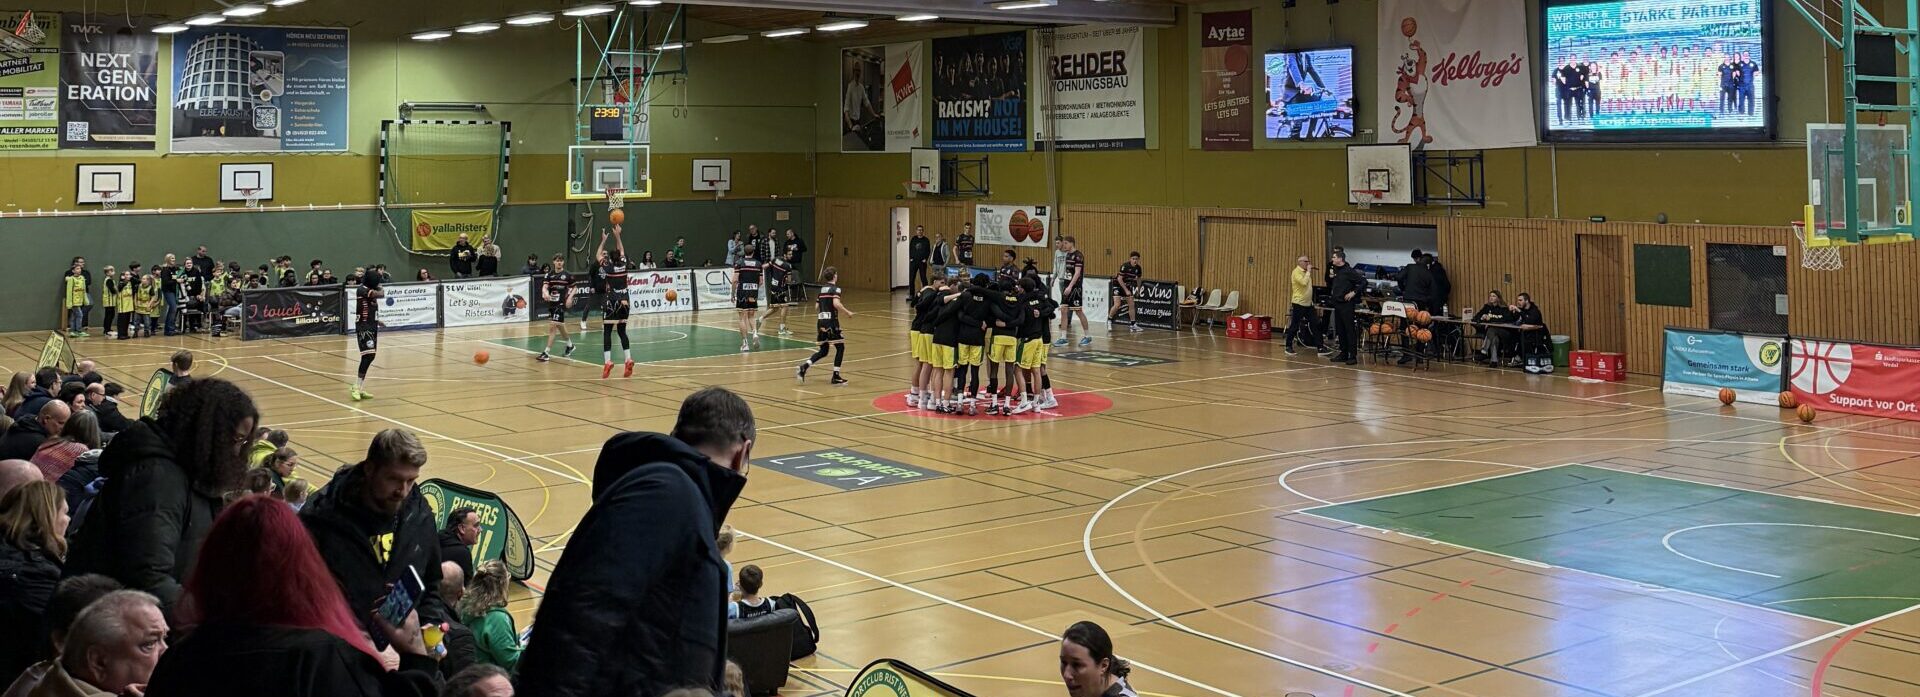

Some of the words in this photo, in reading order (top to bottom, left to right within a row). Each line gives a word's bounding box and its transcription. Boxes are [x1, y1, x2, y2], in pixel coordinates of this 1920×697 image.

[1552, 13, 1571, 22] WIR
[1574, 11, 1598, 20] SIND
[1622, 9, 1676, 23] STARKE
[1682, 3, 1749, 19] PARTNER
[1552, 22, 1571, 31] WIR
[1575, 19, 1616, 29] SUCHEN
[1208, 26, 1245, 40] Aytac
[81, 53, 130, 67] NEXT
[1048, 50, 1127, 79] REHDER
[1432, 50, 1522, 88] Kellogg's
[97, 70, 137, 84] GEN
[68, 86, 149, 102] ERATION
[938, 100, 991, 118] RACISM?
[994, 100, 1020, 116] NOT
[1205, 102, 1218, 112] LETS
[1218, 100, 1226, 109] GO
[1227, 96, 1250, 108] RISTERS
[1217, 110, 1230, 119] LETS
[1231, 108, 1239, 116] GO
[936, 120, 949, 136] IN
[952, 120, 970, 136] MY
[974, 117, 1022, 136] HOUSE!
[980, 214, 1003, 224] EVO
[432, 222, 488, 234] yallaRisters
[980, 224, 1003, 236] NXT
[263, 300, 302, 317] touch
[465, 309, 494, 317] Risters!
[1688, 360, 1728, 371] Gemeinsam
[1830, 394, 1873, 407] Support
[1876, 401, 1894, 409] vor
[1896, 401, 1918, 412] Ort.
[816, 452, 923, 478] BARMER
[884, 672, 899, 688] RIST
